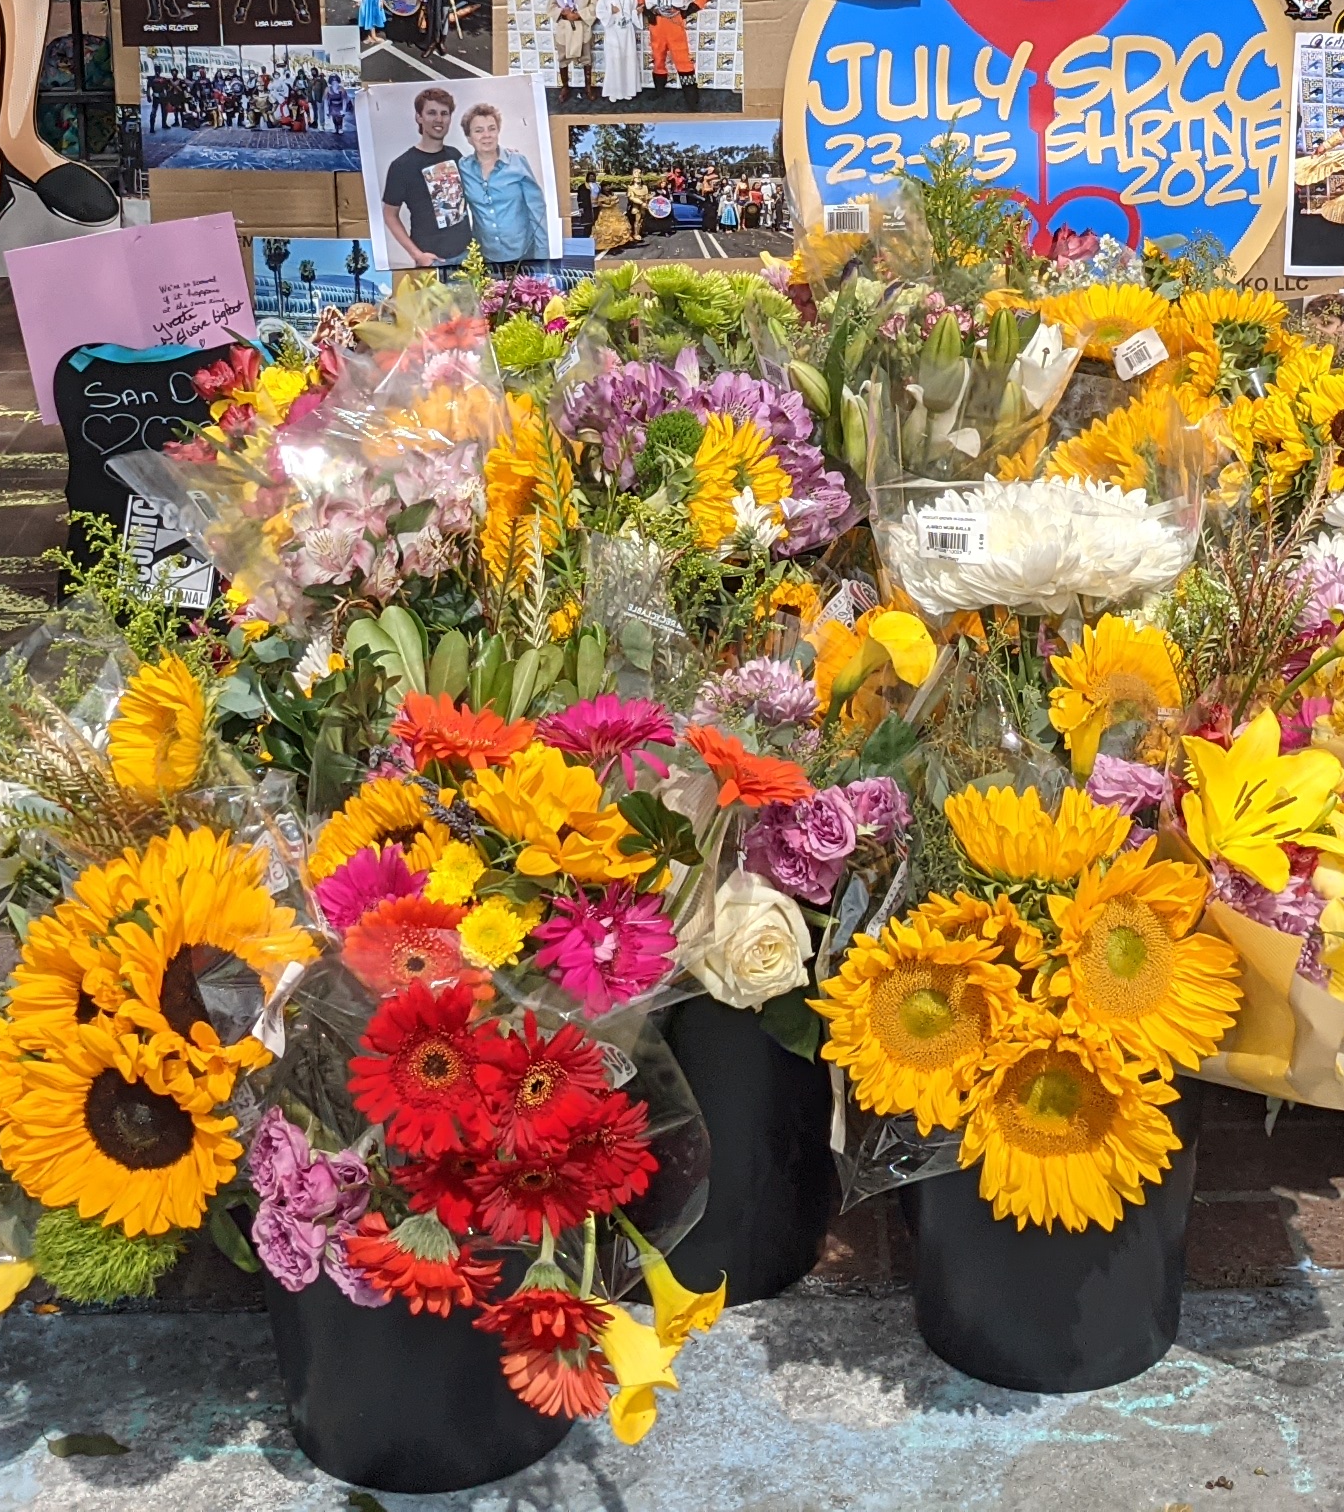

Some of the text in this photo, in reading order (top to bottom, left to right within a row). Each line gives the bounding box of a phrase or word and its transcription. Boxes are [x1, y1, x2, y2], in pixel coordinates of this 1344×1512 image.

[807, 32, 1282, 127] JULY SDCC
[1046, 107, 1284, 167] SHRINE
[1120, 155, 1277, 207] 2021
[1274, 277, 1309, 291] LLC
